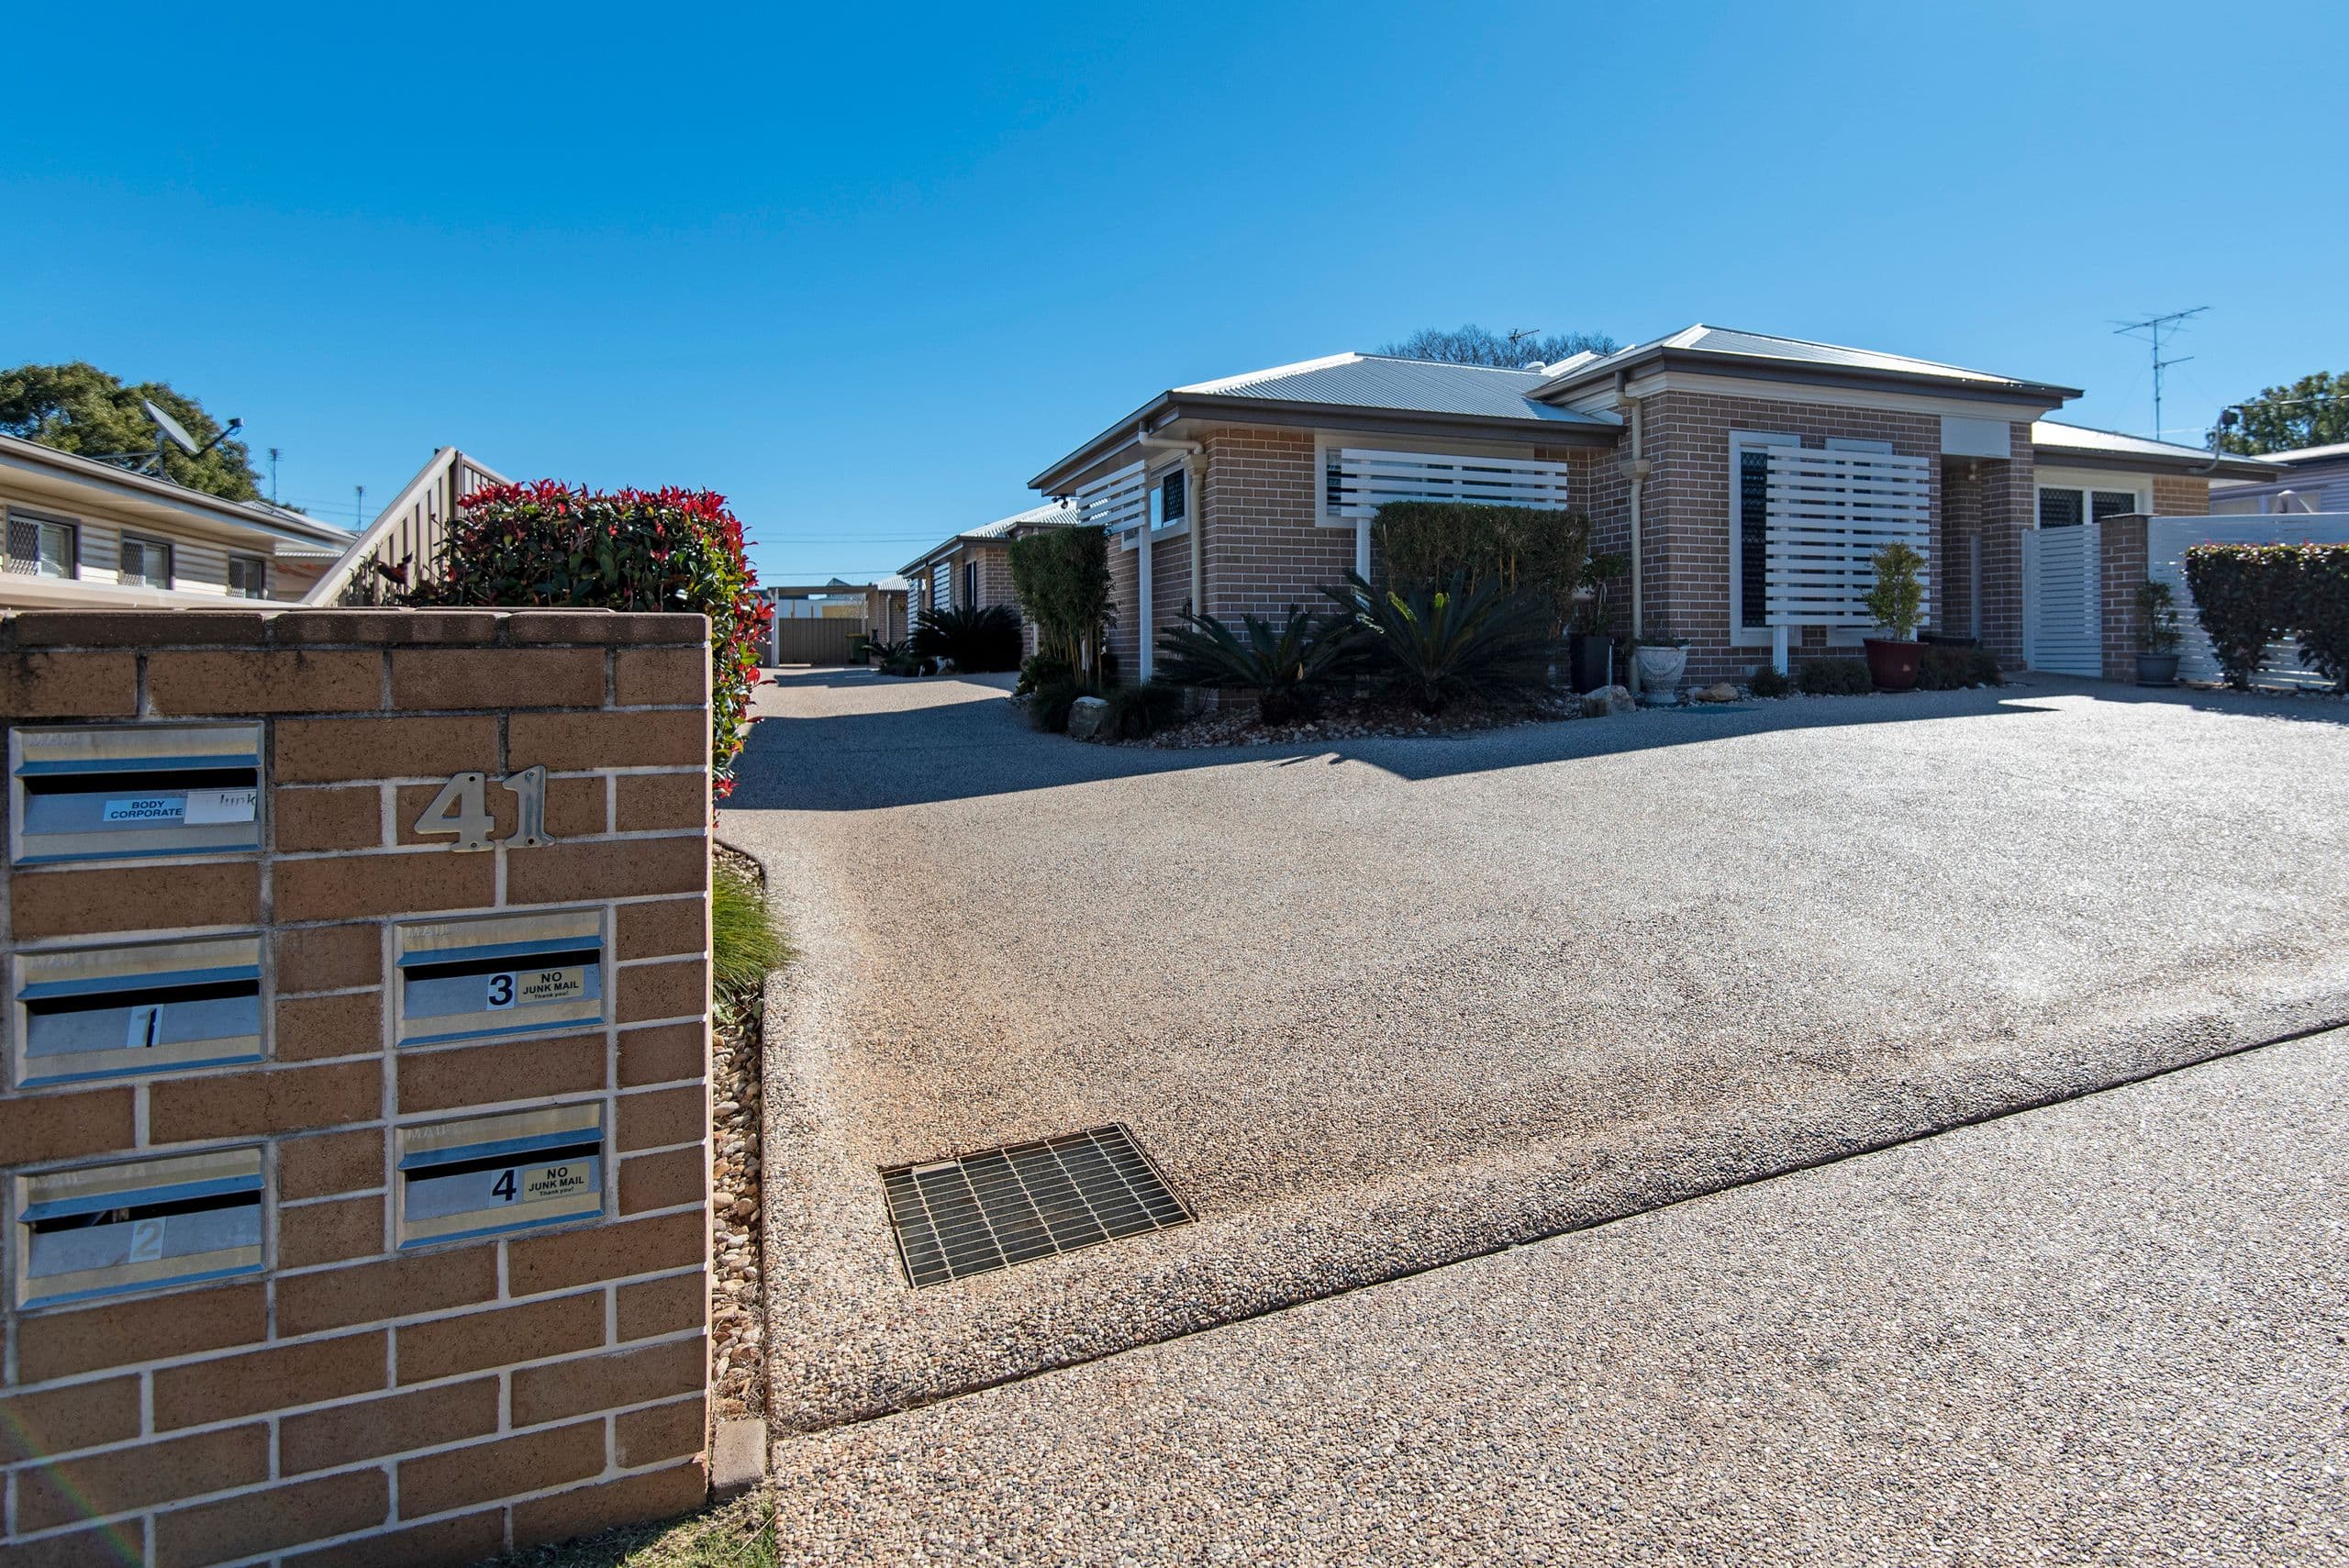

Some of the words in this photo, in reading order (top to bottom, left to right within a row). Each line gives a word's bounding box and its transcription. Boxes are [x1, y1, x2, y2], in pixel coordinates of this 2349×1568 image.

[132, 800, 165, 809] BODY
[414, 764, 555, 852] 41
[110, 808, 183, 819] CORPORATE
[541, 972, 562, 984] NO
[488, 974, 513, 1006] 3
[523, 984, 551, 995] JUNK
[554, 981, 579, 991] MAIL
[547, 1167, 568, 1179] NO
[492, 1170, 517, 1201] 4
[529, 1180, 557, 1192] JUNK
[560, 1176, 584, 1186] MAIL
[135, 1220, 162, 1258] 2
